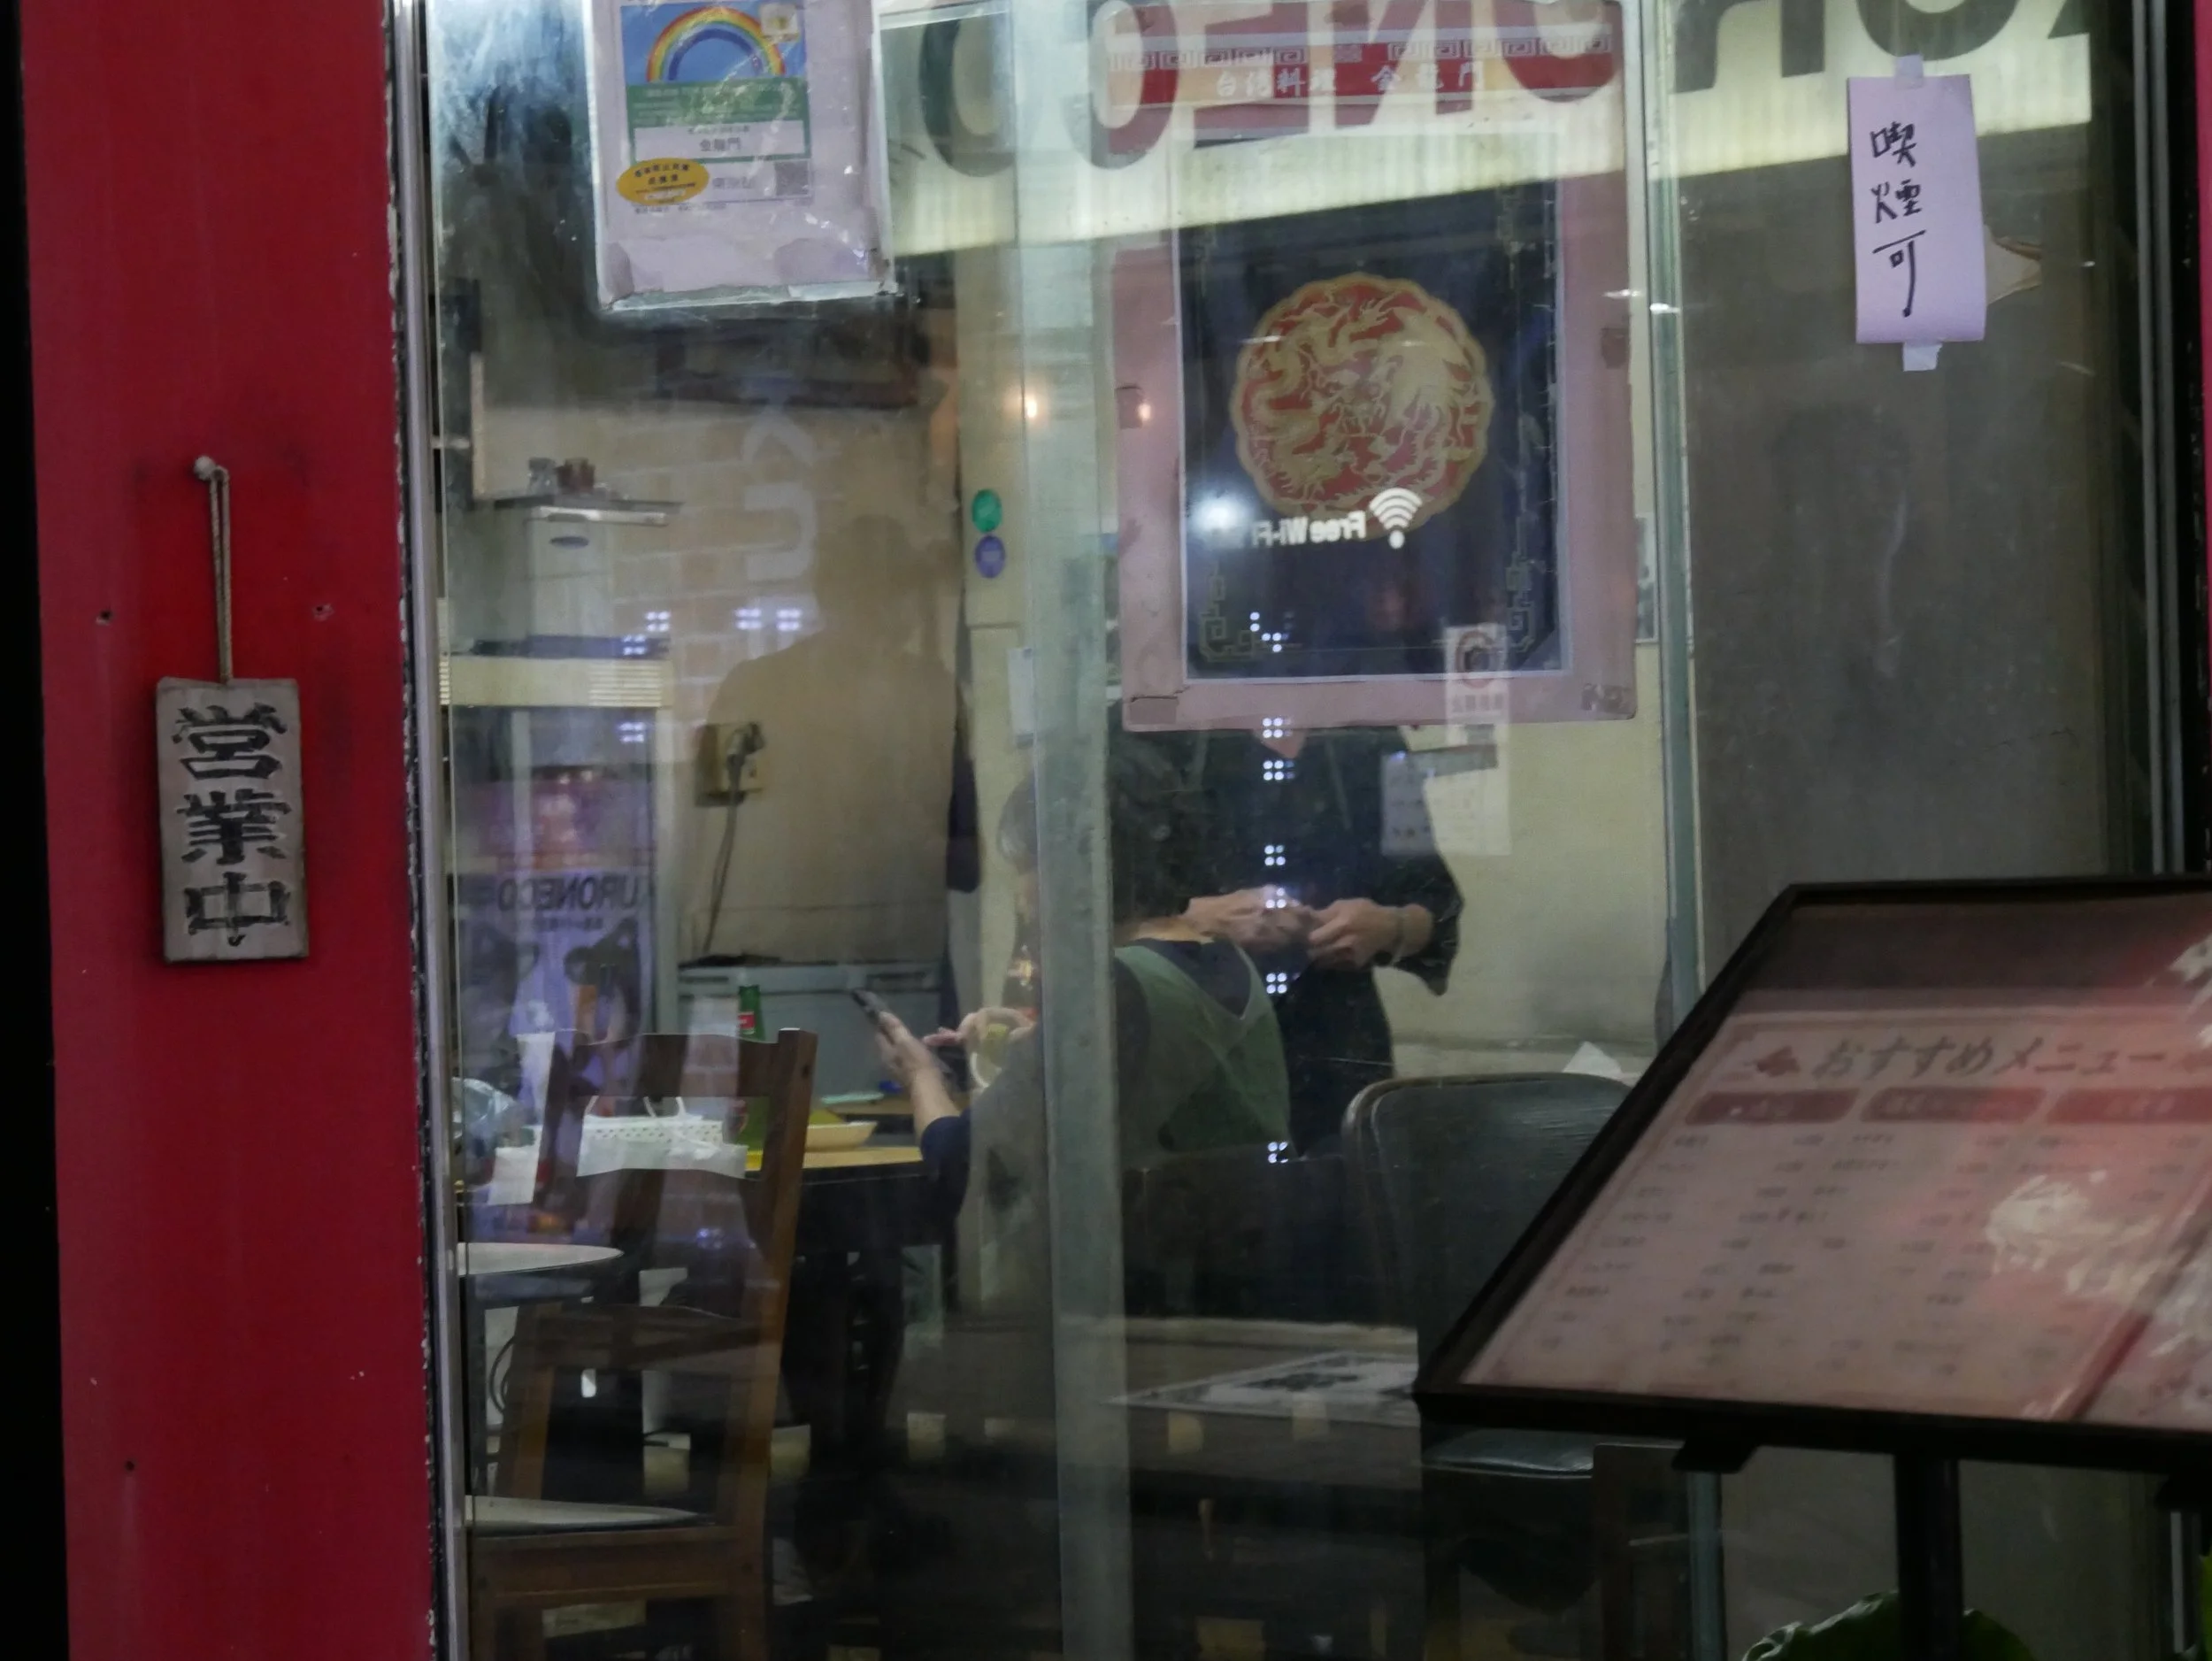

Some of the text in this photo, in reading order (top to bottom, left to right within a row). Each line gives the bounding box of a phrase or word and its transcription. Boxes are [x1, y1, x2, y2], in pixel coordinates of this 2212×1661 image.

[1869, 120, 1927, 318] 喫煙可
[172, 703, 292, 947] 営業中
[1811, 1036, 2167, 1080] おすすめメニュー
